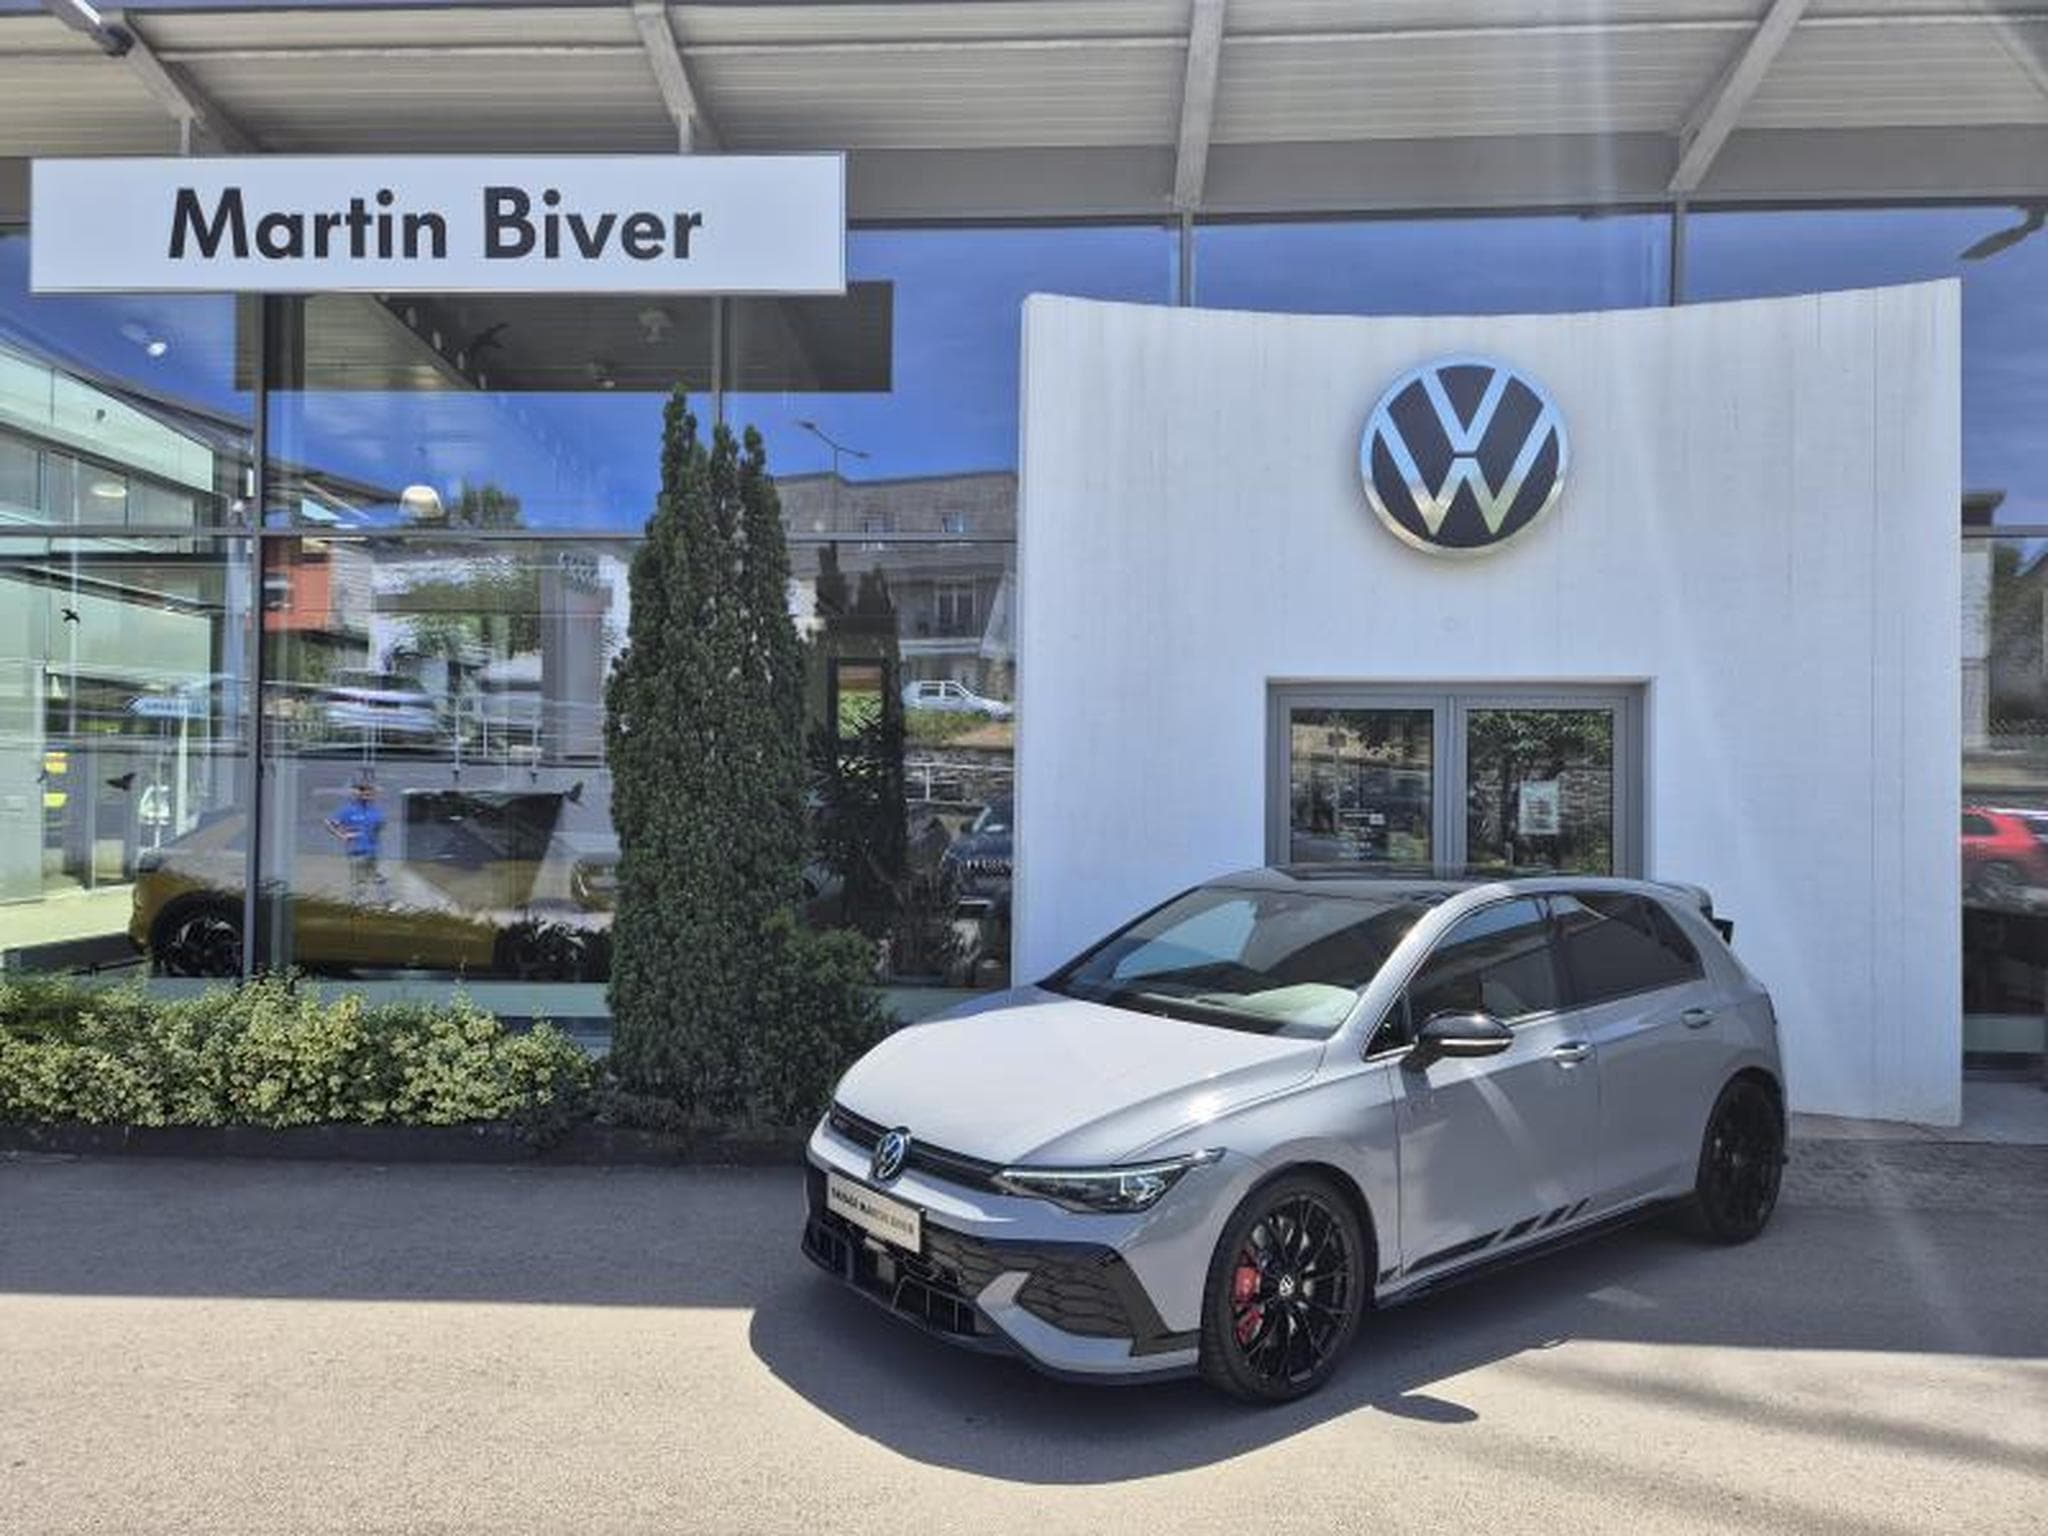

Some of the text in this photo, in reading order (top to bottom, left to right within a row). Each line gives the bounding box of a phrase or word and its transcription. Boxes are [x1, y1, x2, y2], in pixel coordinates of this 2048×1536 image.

[167, 185, 703, 260] Martin Biver
[1366, 358, 1563, 544] VW
